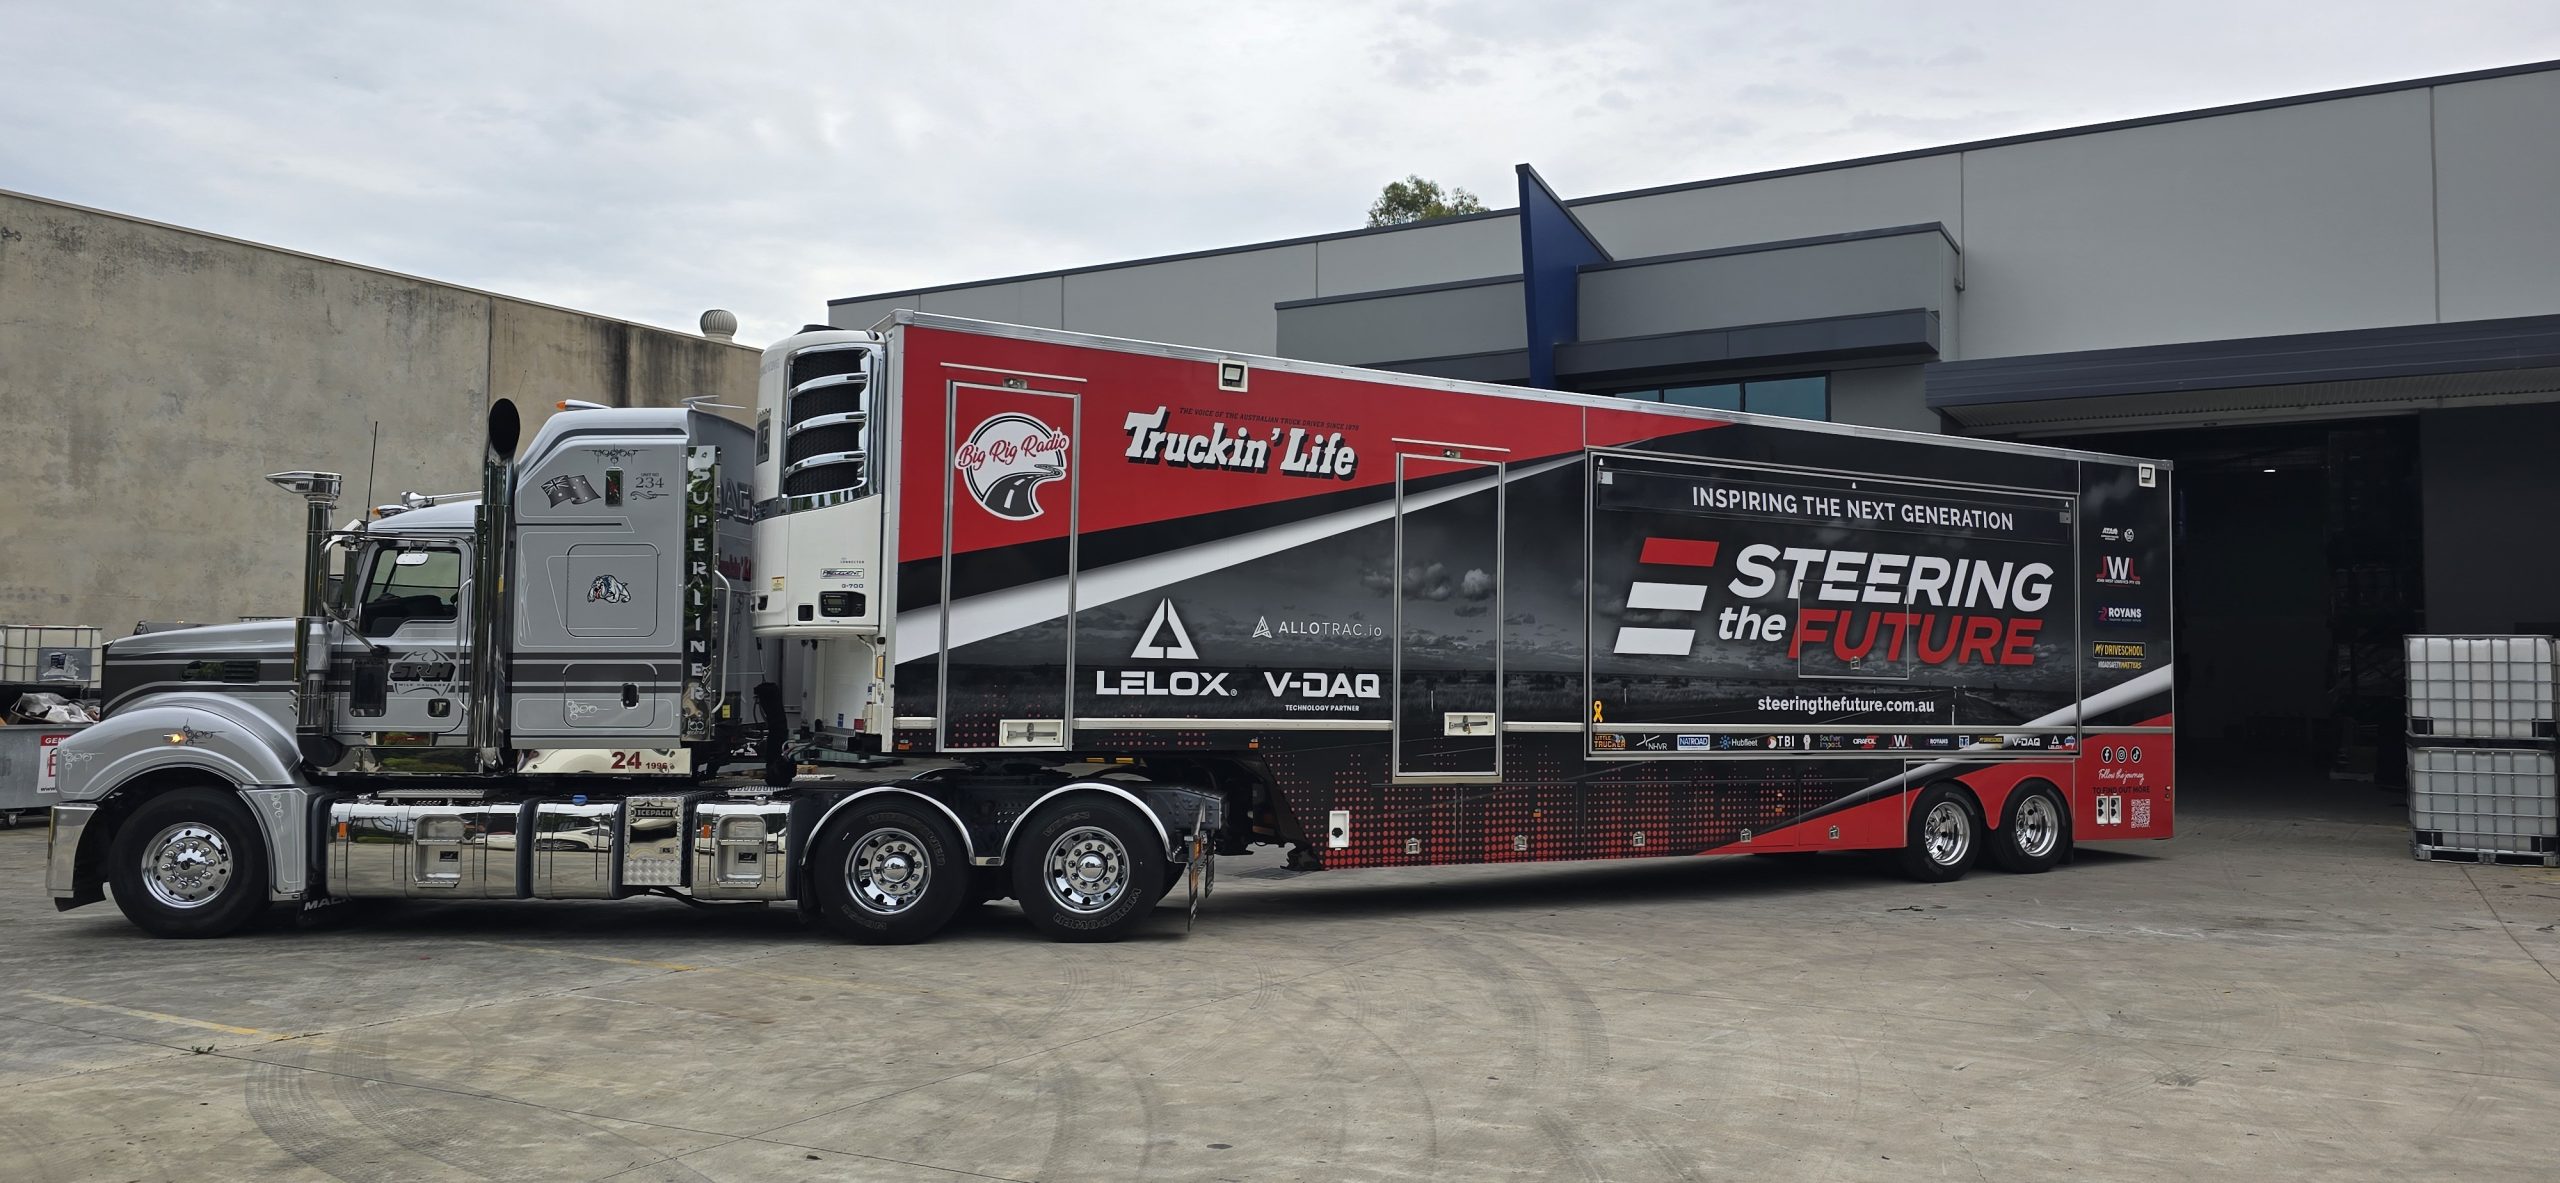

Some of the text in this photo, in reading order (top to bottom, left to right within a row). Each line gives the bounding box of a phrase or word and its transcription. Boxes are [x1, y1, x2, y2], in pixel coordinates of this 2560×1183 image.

[1179, 407, 1193, 415] THE
[1194, 409, 1214, 417] VOICE
[1225, 412, 1239, 420] THE
[1240, 413, 1280, 423] AUSTRALIAN
[1281, 417, 1300, 425] TRUCK
[1302, 419, 1325, 428] DRIVER
[1326, 422, 1345, 430] SINCE
[958, 432, 1067, 471] Big Rig Radio
[1279, 427, 1356, 476] Life
[635, 477, 665, 488] 234
[1692, 486, 2013, 531] INSPIRING THE NEXT GENERATION
[2096, 555, 2141, 580] JWL
[690, 467, 711, 700] SUPERLINER
[1728, 543, 2055, 612] STEERING
[2108, 607, 2142, 618] ROYANS
[1278, 621, 1382, 637] ALLOTRAC.io
[1718, 606, 2043, 665] the FUTURE
[2095, 643, 2144, 657] MY DRIVESCHOOL
[1263, 671, 1381, 698] V-DAQ
[1757, 695, 1935, 714] steeringthefuture.com.au
[1680, 737, 1708, 746] NATROAD
[1731, 738, 1758, 747] Hubfleet
[1778, 735, 1795, 747] TBI
[2012, 737, 2041, 747] V-DAQ
[611, 751, 641, 769] 24
[2098, 768, 2115, 780] Follow
[2093, 786, 2101, 794] TO
[2118, 786, 2132, 794] OUT
[2133, 785, 2150, 793] MORE
[304, 896, 349, 911] MAC
